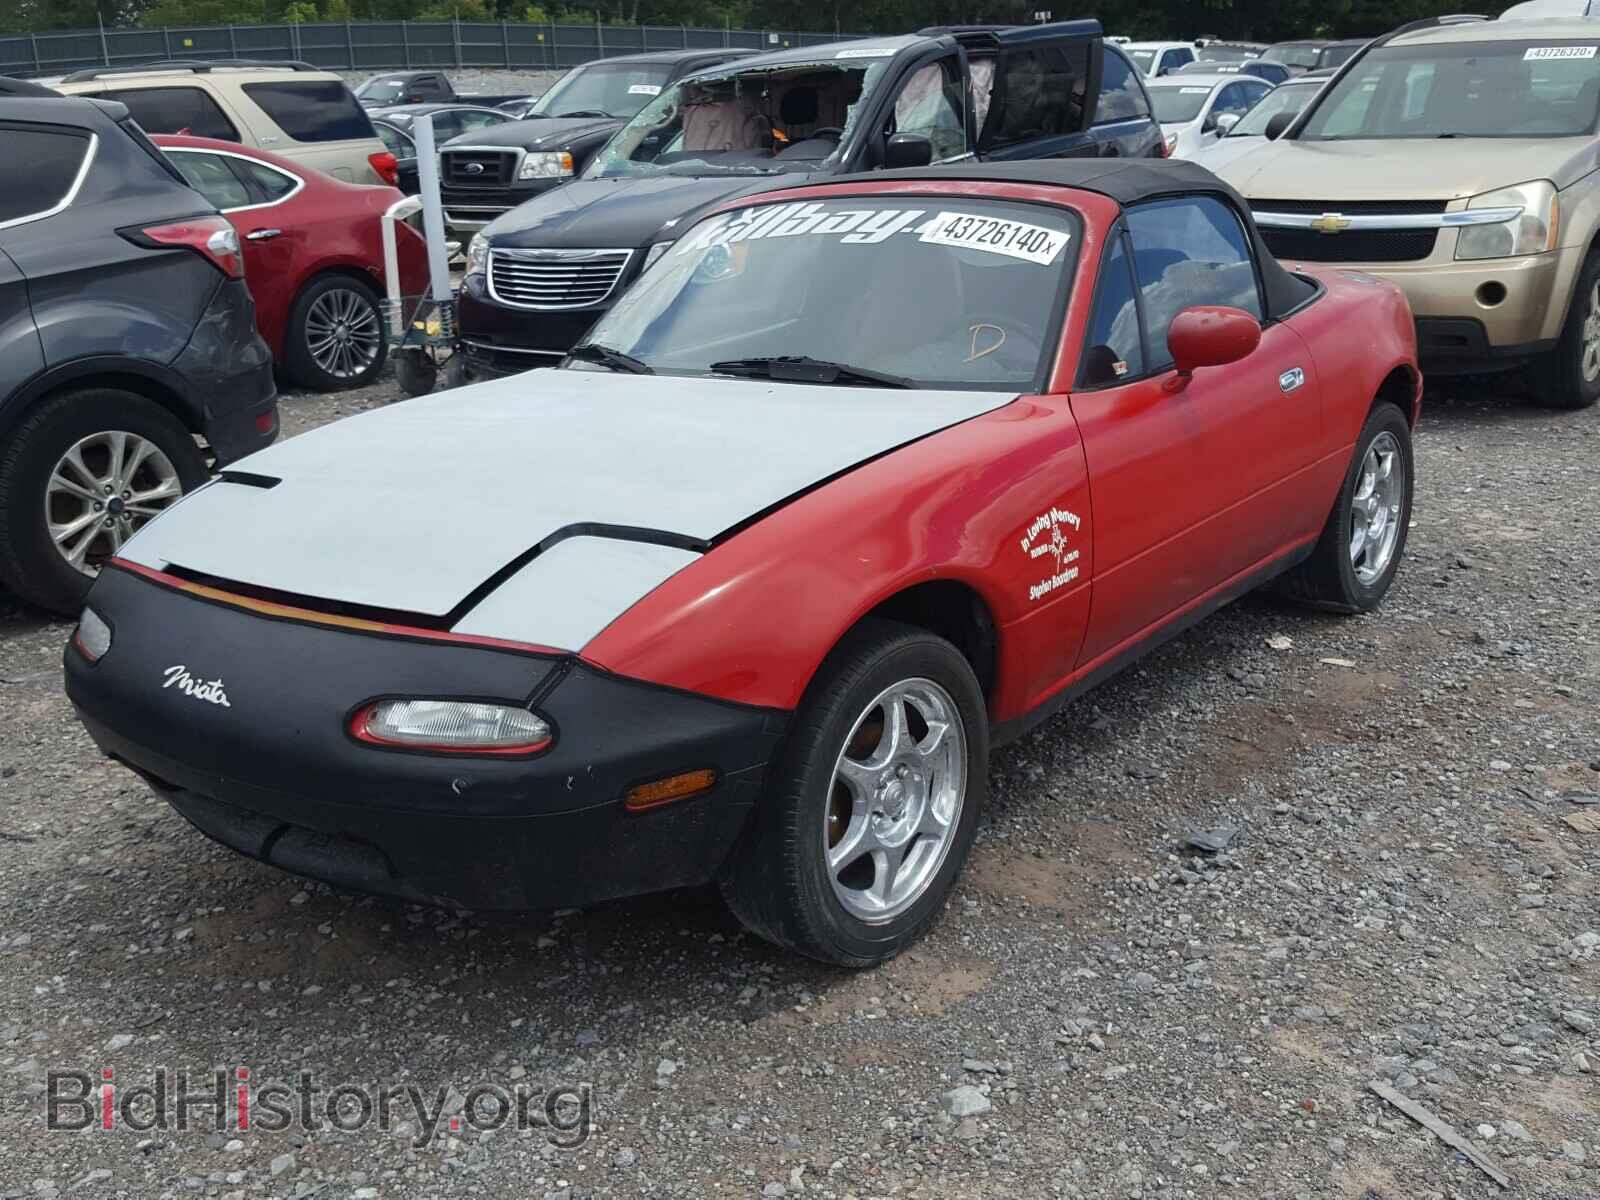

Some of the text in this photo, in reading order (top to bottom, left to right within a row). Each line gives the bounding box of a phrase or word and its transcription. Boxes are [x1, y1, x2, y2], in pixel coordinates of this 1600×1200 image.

[962, 323, 1006, 362] D
[1027, 513, 1051, 541] Loving
[1050, 507, 1080, 531] Memory
[162, 665, 231, 707] Miata
